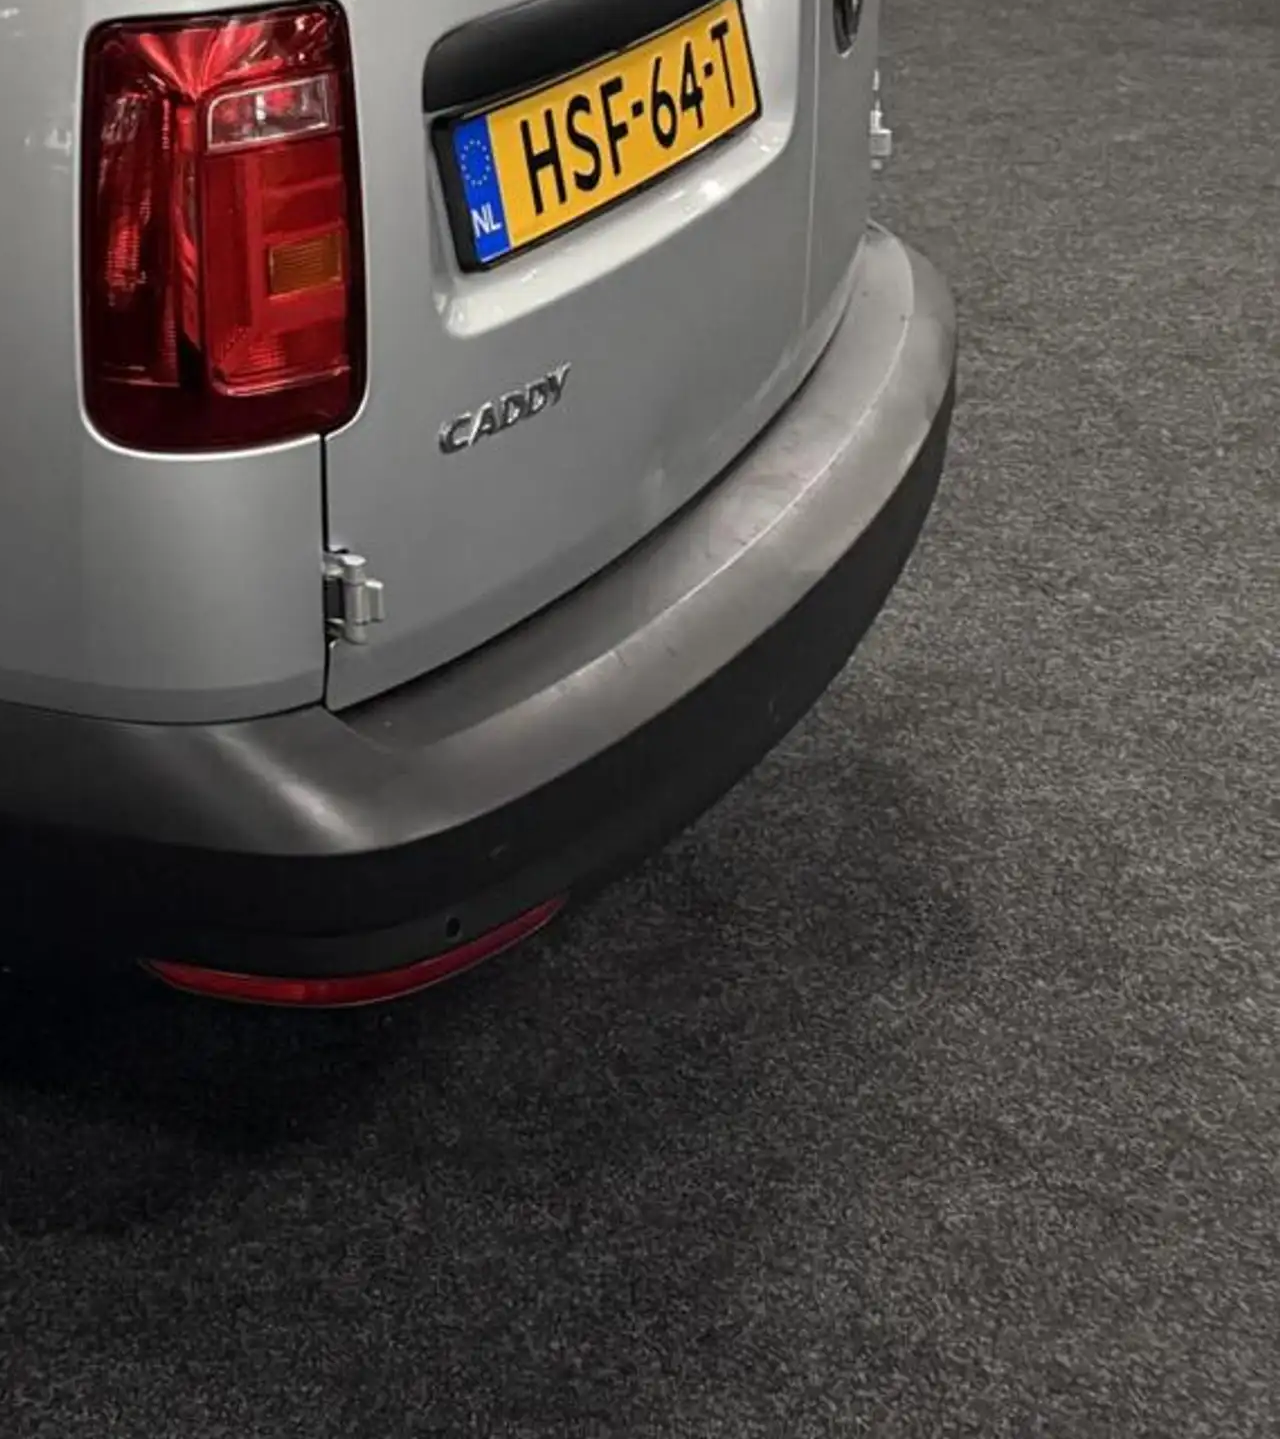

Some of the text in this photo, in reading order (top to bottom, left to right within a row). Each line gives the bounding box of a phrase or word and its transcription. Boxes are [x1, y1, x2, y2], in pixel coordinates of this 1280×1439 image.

[472, 20, 733, 236] NL HSF-64-T
[438, 361, 572, 455] CADDY
